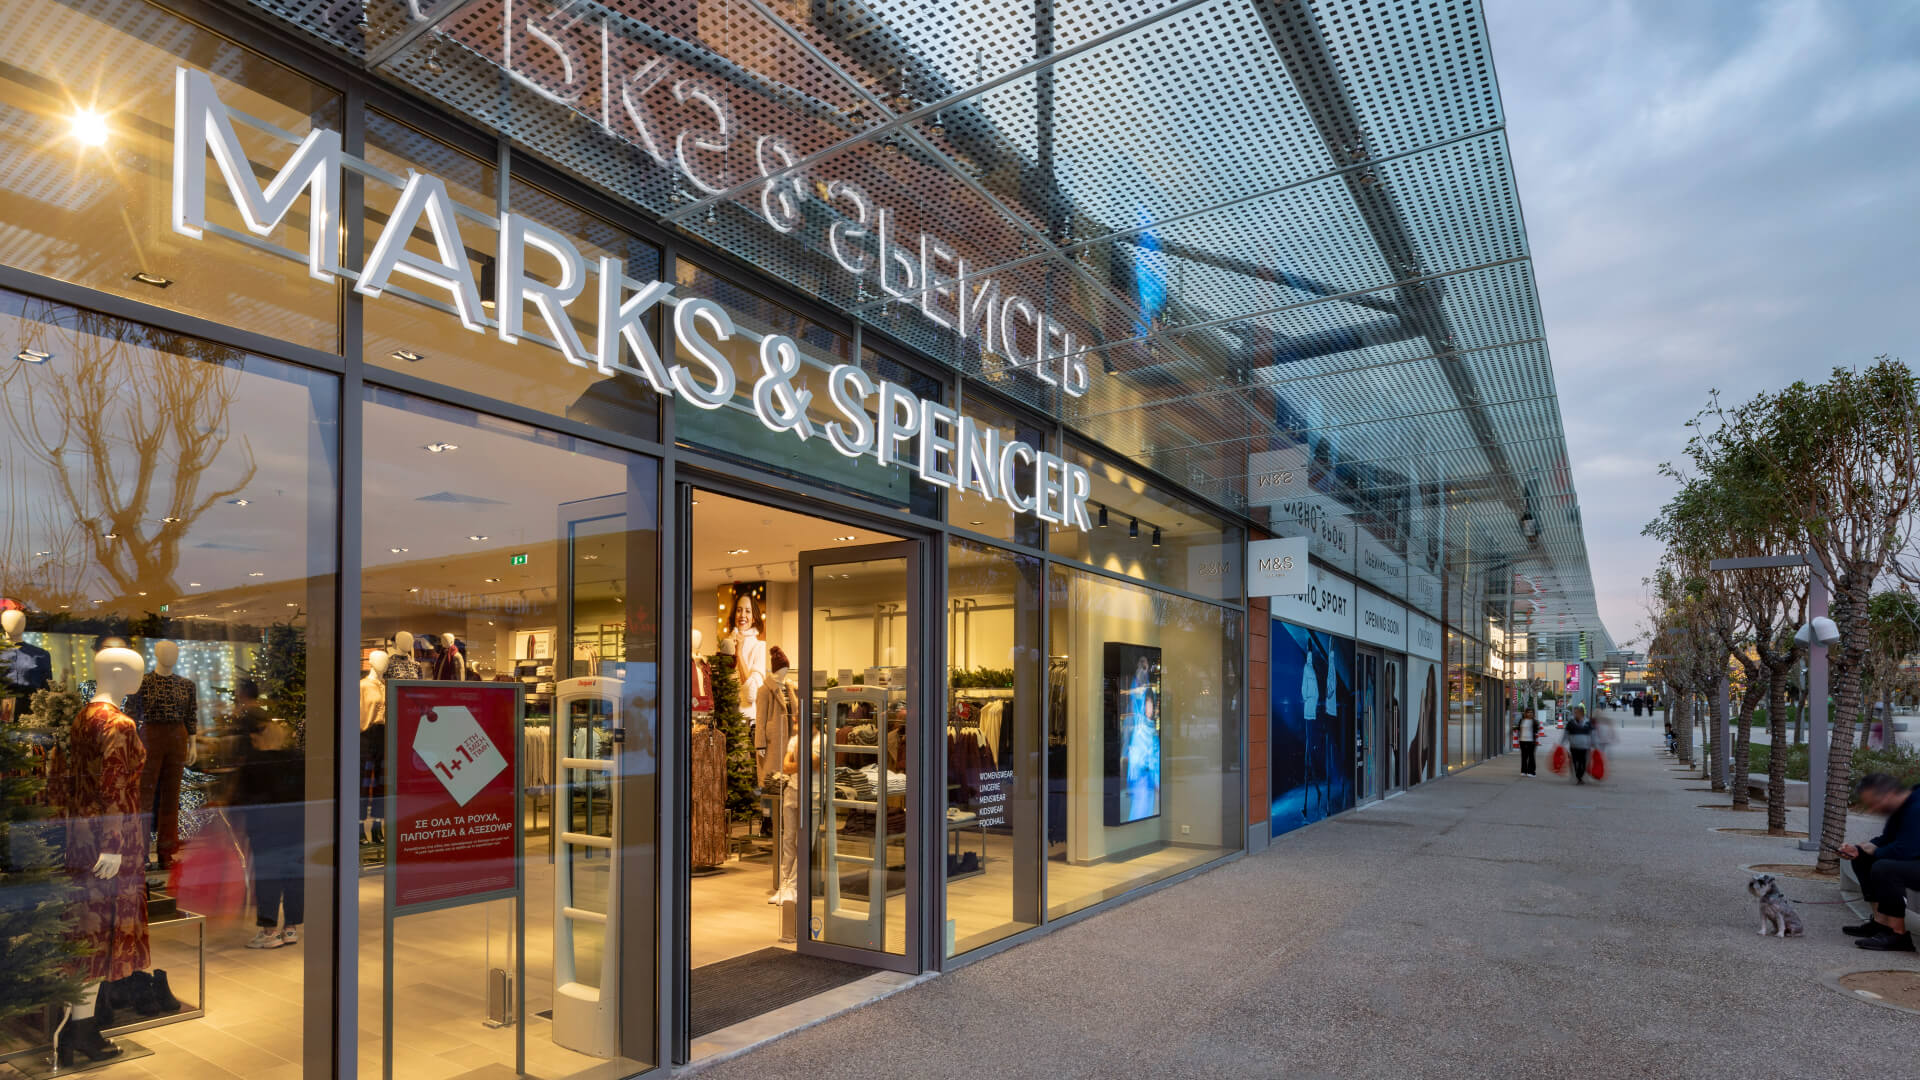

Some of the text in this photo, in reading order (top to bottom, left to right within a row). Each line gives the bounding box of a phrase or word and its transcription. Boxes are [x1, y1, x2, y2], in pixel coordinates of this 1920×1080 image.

[172, 66, 1093, 532] MARKS & SPENCER
[1258, 555, 1293, 572] M&S
[1364, 609, 1400, 635] OPENING SOON
[434, 744, 474, 781] 1+1
[979, 771, 1013, 780] WOMENSWEAR
[979, 783, 1001, 792] LINGERIE
[979, 793, 1006, 804] MENSWEAR
[979, 805, 1004, 815] KIDSWEAR
[415, 819, 429, 829] ΣΕ
[431, 816, 451, 828] ΟΛΑ
[453, 815, 466, 825] ΤΑ
[979, 816, 1005, 827] FOODHALL
